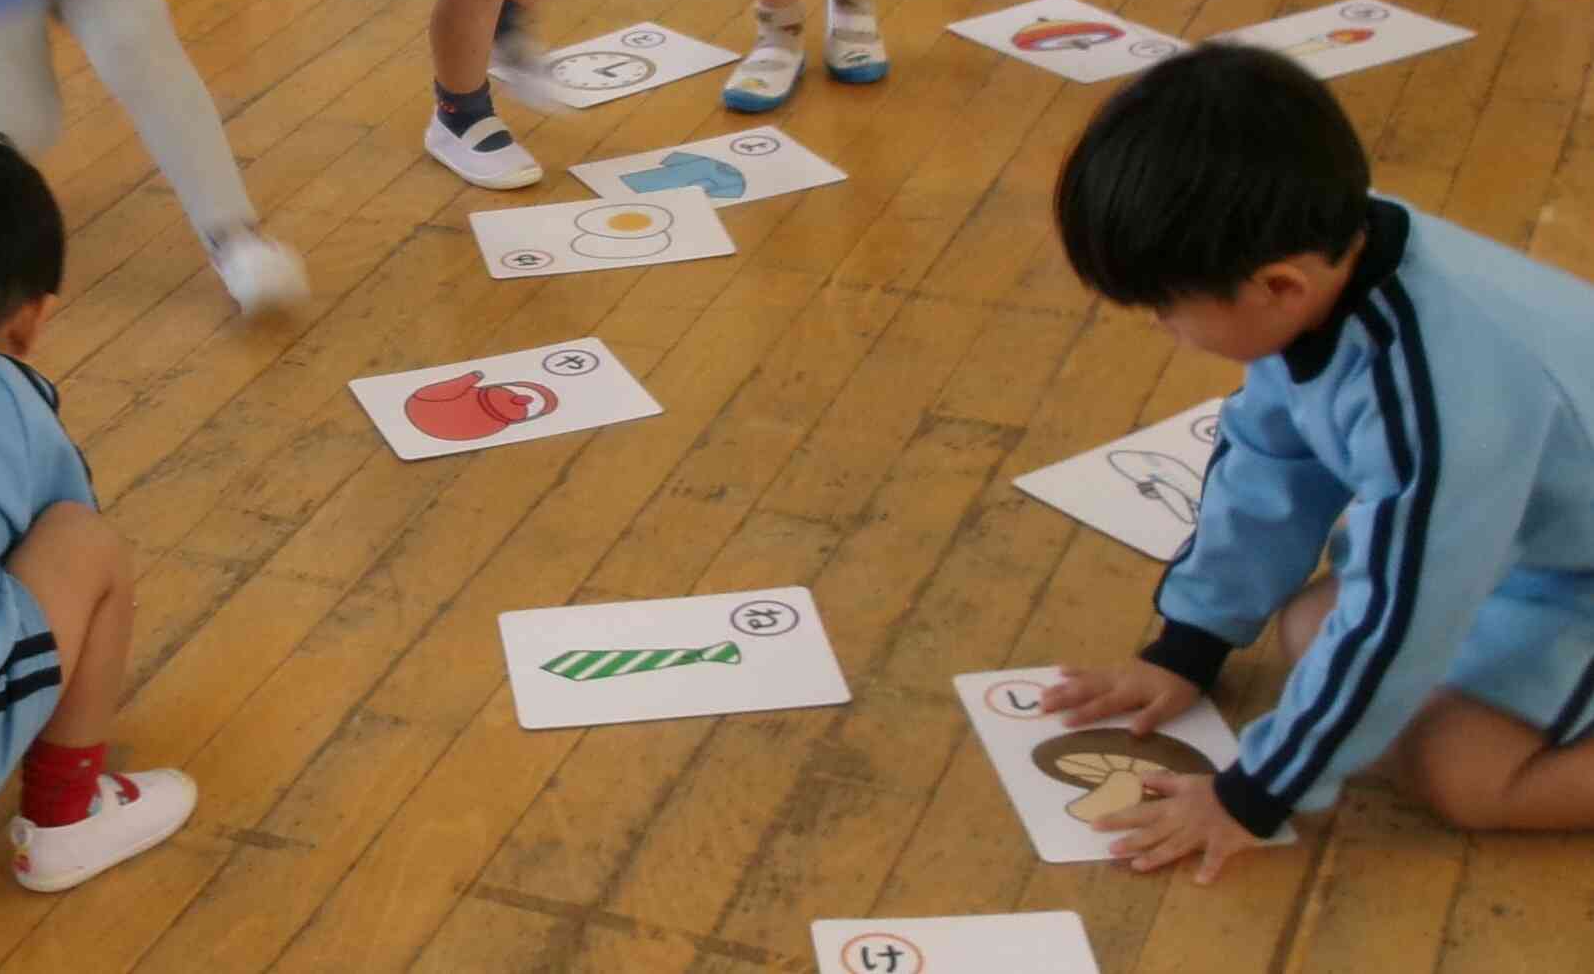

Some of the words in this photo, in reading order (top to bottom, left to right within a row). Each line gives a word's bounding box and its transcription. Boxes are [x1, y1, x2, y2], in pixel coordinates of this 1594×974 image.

[745, 609, 784, 629] ね
[1006, 689, 1040, 711] し
[862, 944, 905, 973] け
